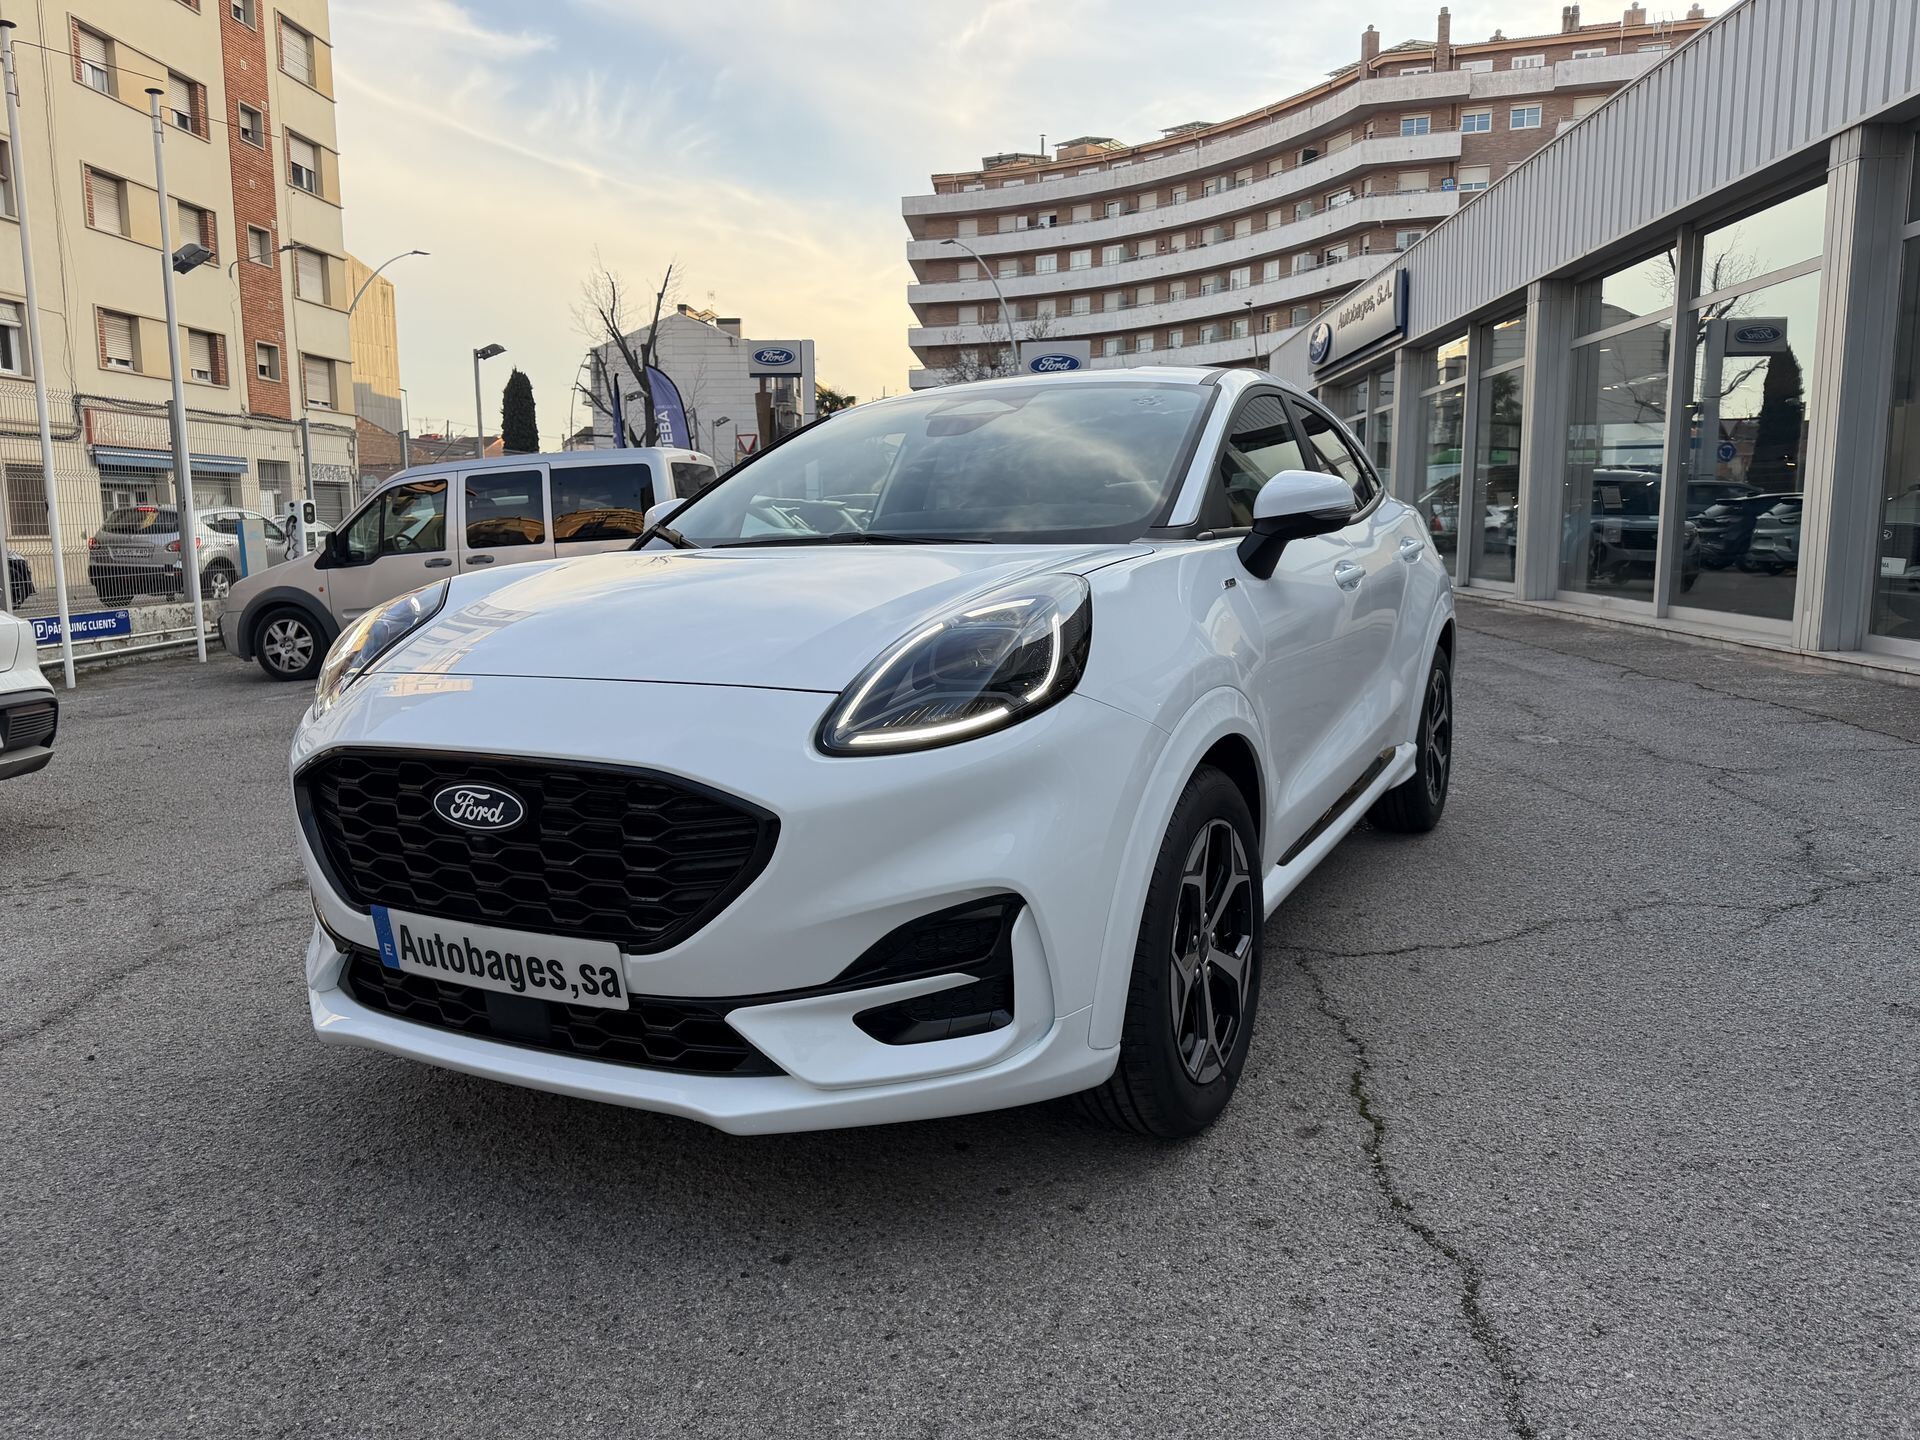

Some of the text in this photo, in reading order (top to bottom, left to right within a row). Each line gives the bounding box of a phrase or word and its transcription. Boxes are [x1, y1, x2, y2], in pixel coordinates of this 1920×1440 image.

[1337, 279, 1392, 331] Autobages, S.A.
[761, 350, 787, 361] Ford
[1039, 357, 1070, 371] Ford
[48, 621, 87, 635] PÀRUING
[88, 618, 117, 631] CLIENTS
[450, 790, 504, 823] Ford
[384, 924, 622, 999] E Autobages,sa
